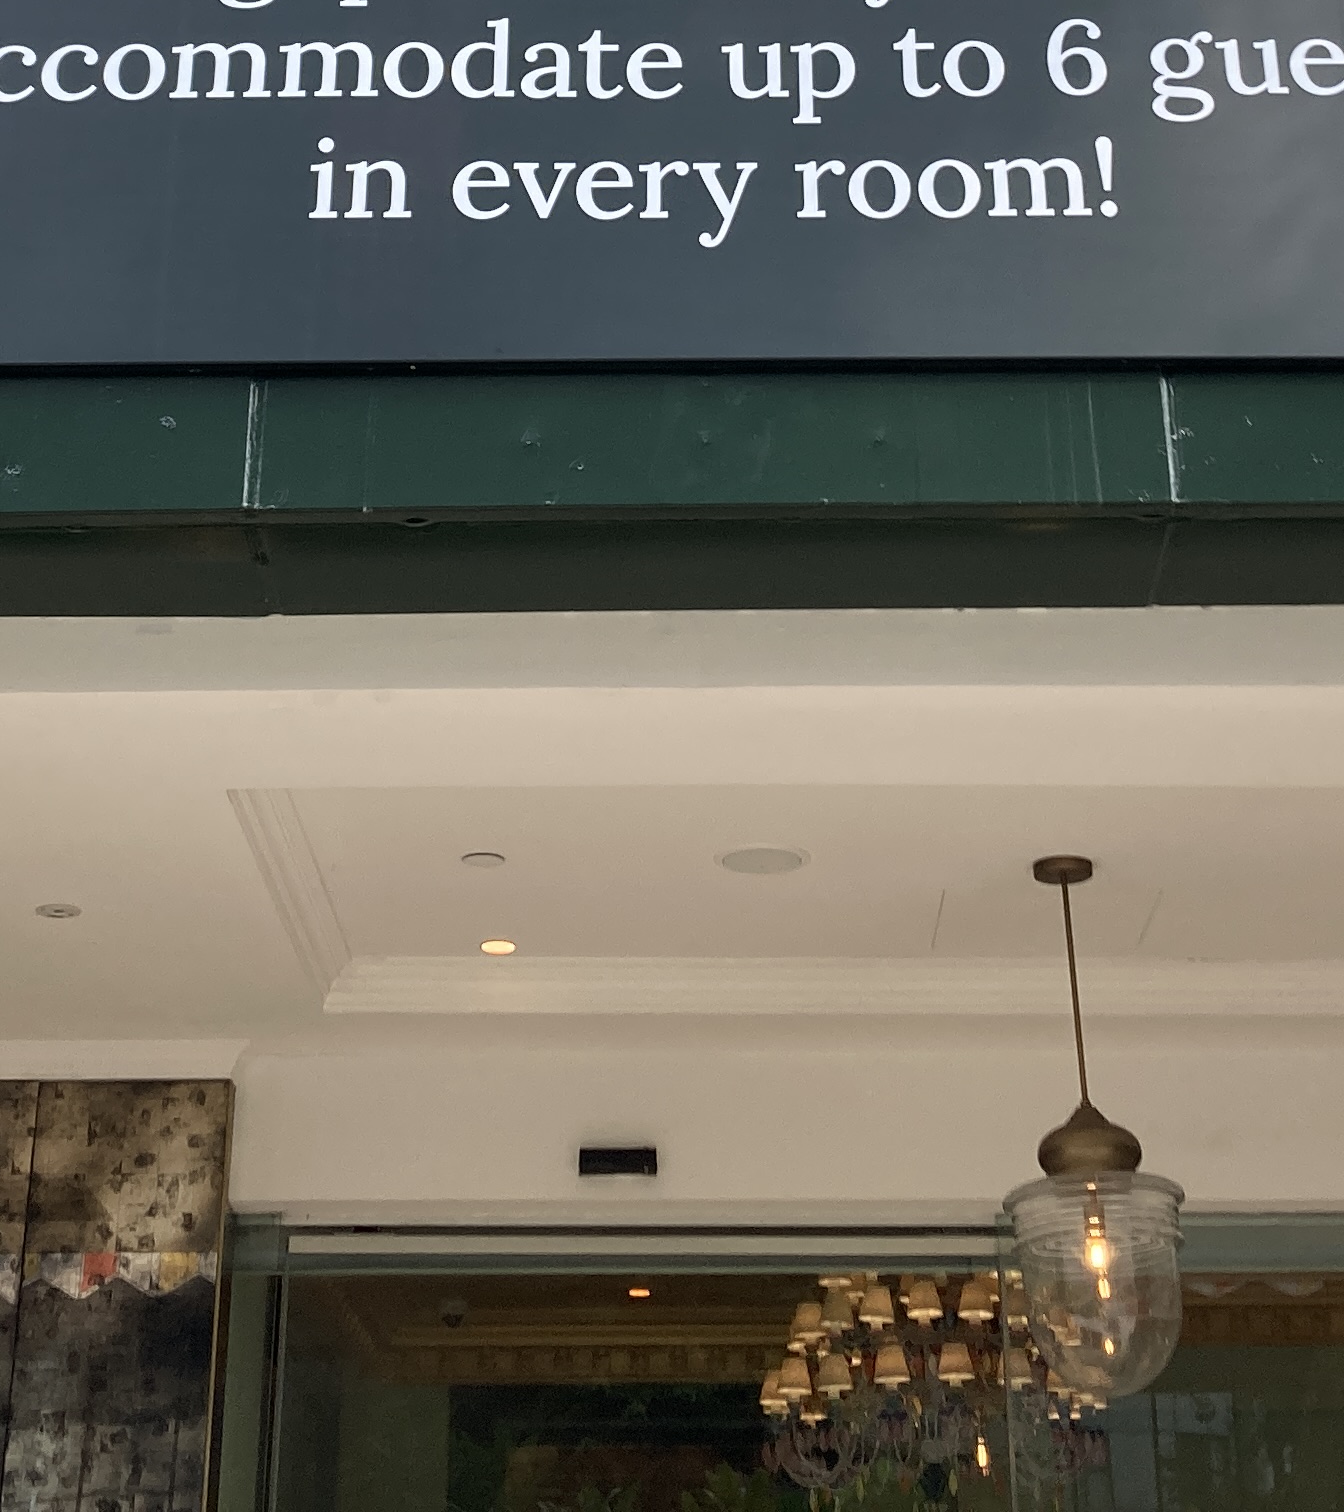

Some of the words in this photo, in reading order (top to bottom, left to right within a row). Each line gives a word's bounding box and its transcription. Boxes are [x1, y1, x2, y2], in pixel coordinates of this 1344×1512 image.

[720, 40, 857, 126] up
[891, 27, 1006, 99] to
[1045, 17, 1109, 97] 6
[307, 135, 413, 220] in
[451, 159, 759, 248] every
[793, 134, 1120, 220] room!
